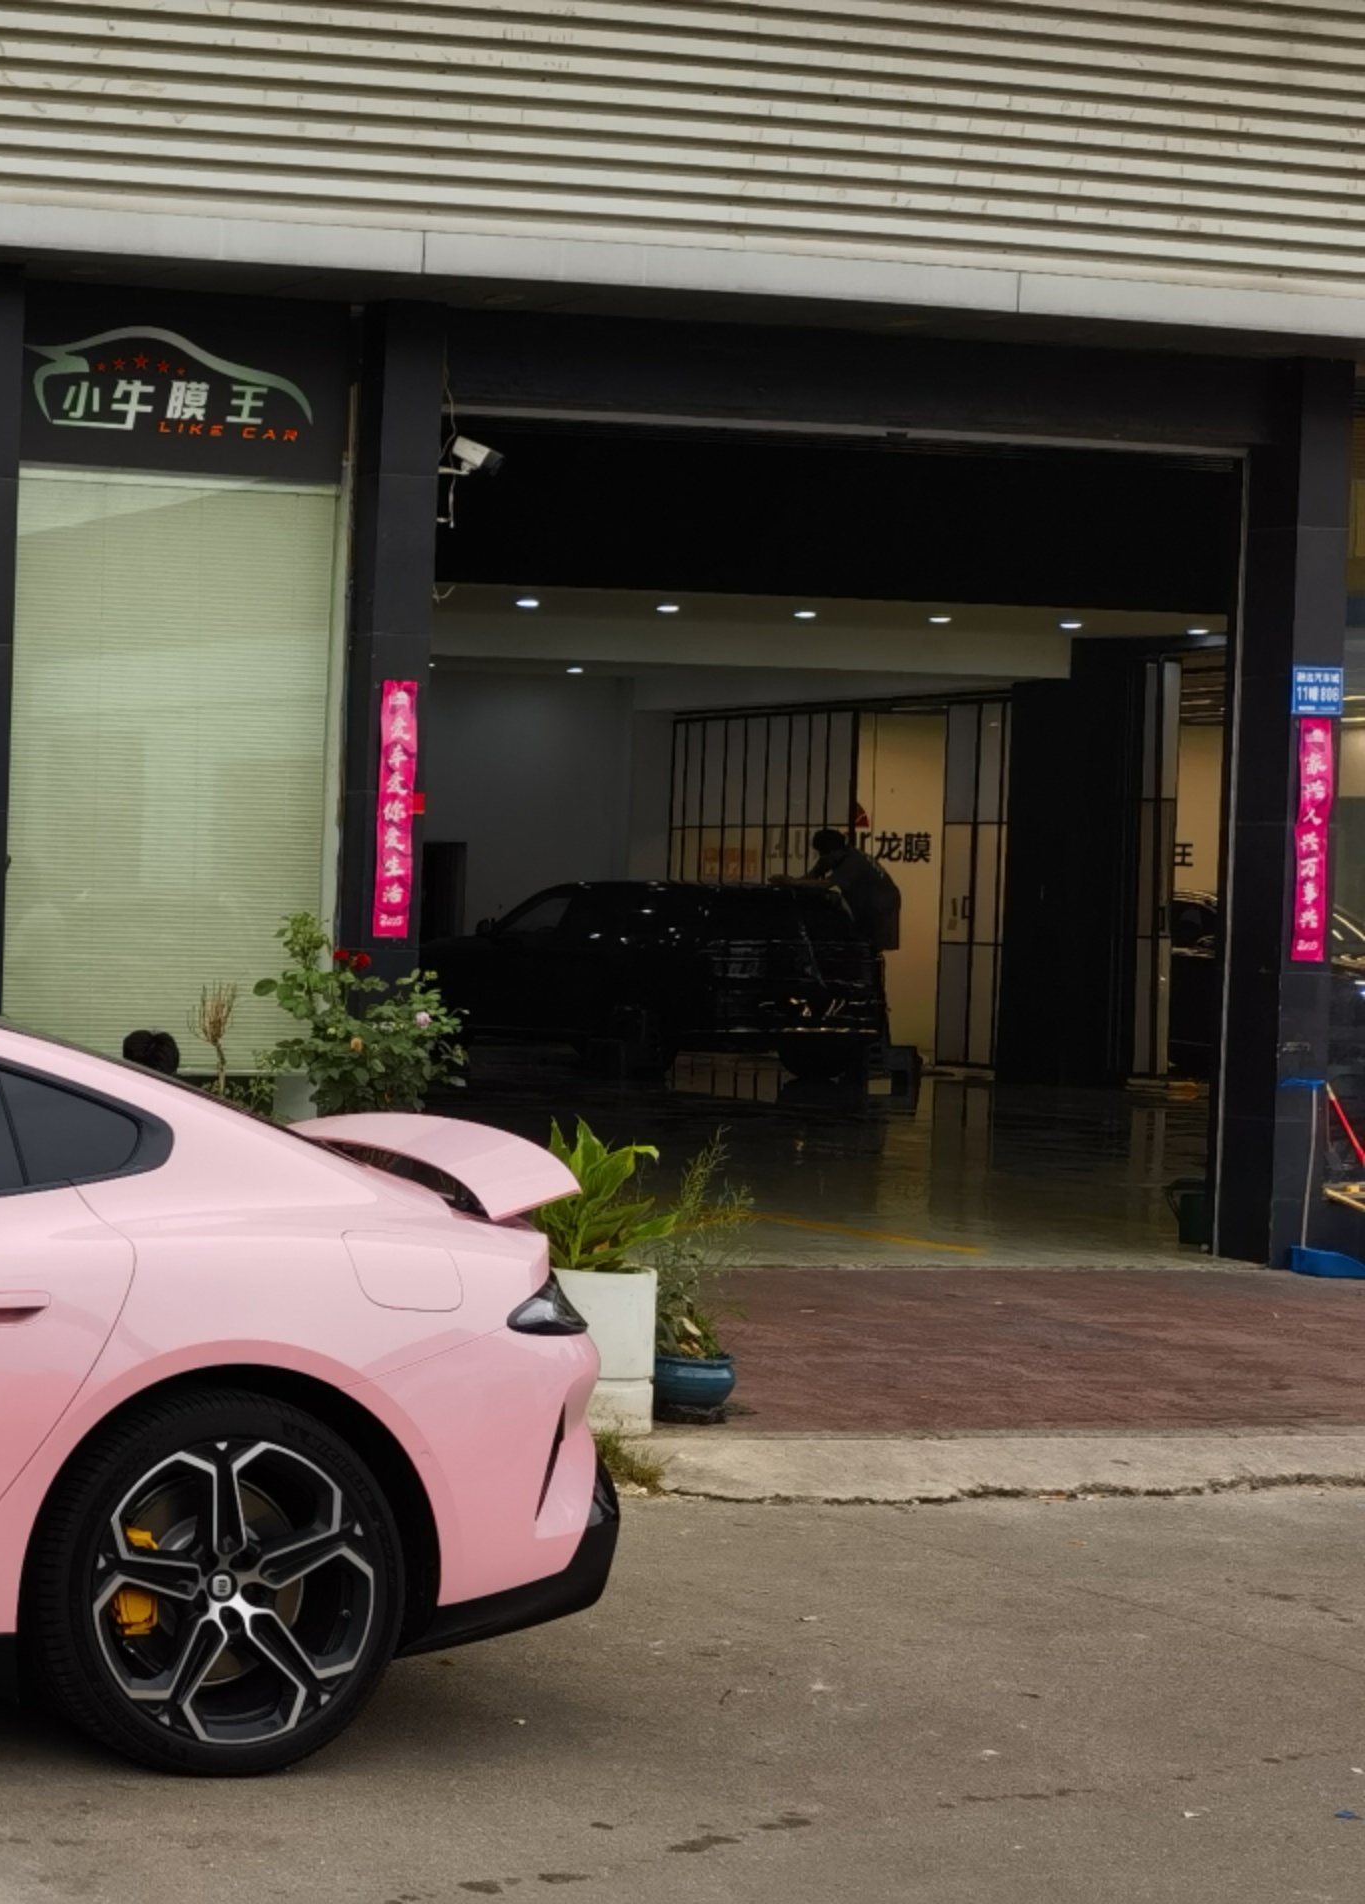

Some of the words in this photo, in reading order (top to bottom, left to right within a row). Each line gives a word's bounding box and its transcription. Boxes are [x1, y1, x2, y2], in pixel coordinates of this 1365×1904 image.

[62, 379, 268, 430] 小牛膜王
[158, 422, 224, 436] LIKE
[242, 427, 298, 442] CAR
[873, 831, 931, 863] 龙膜
